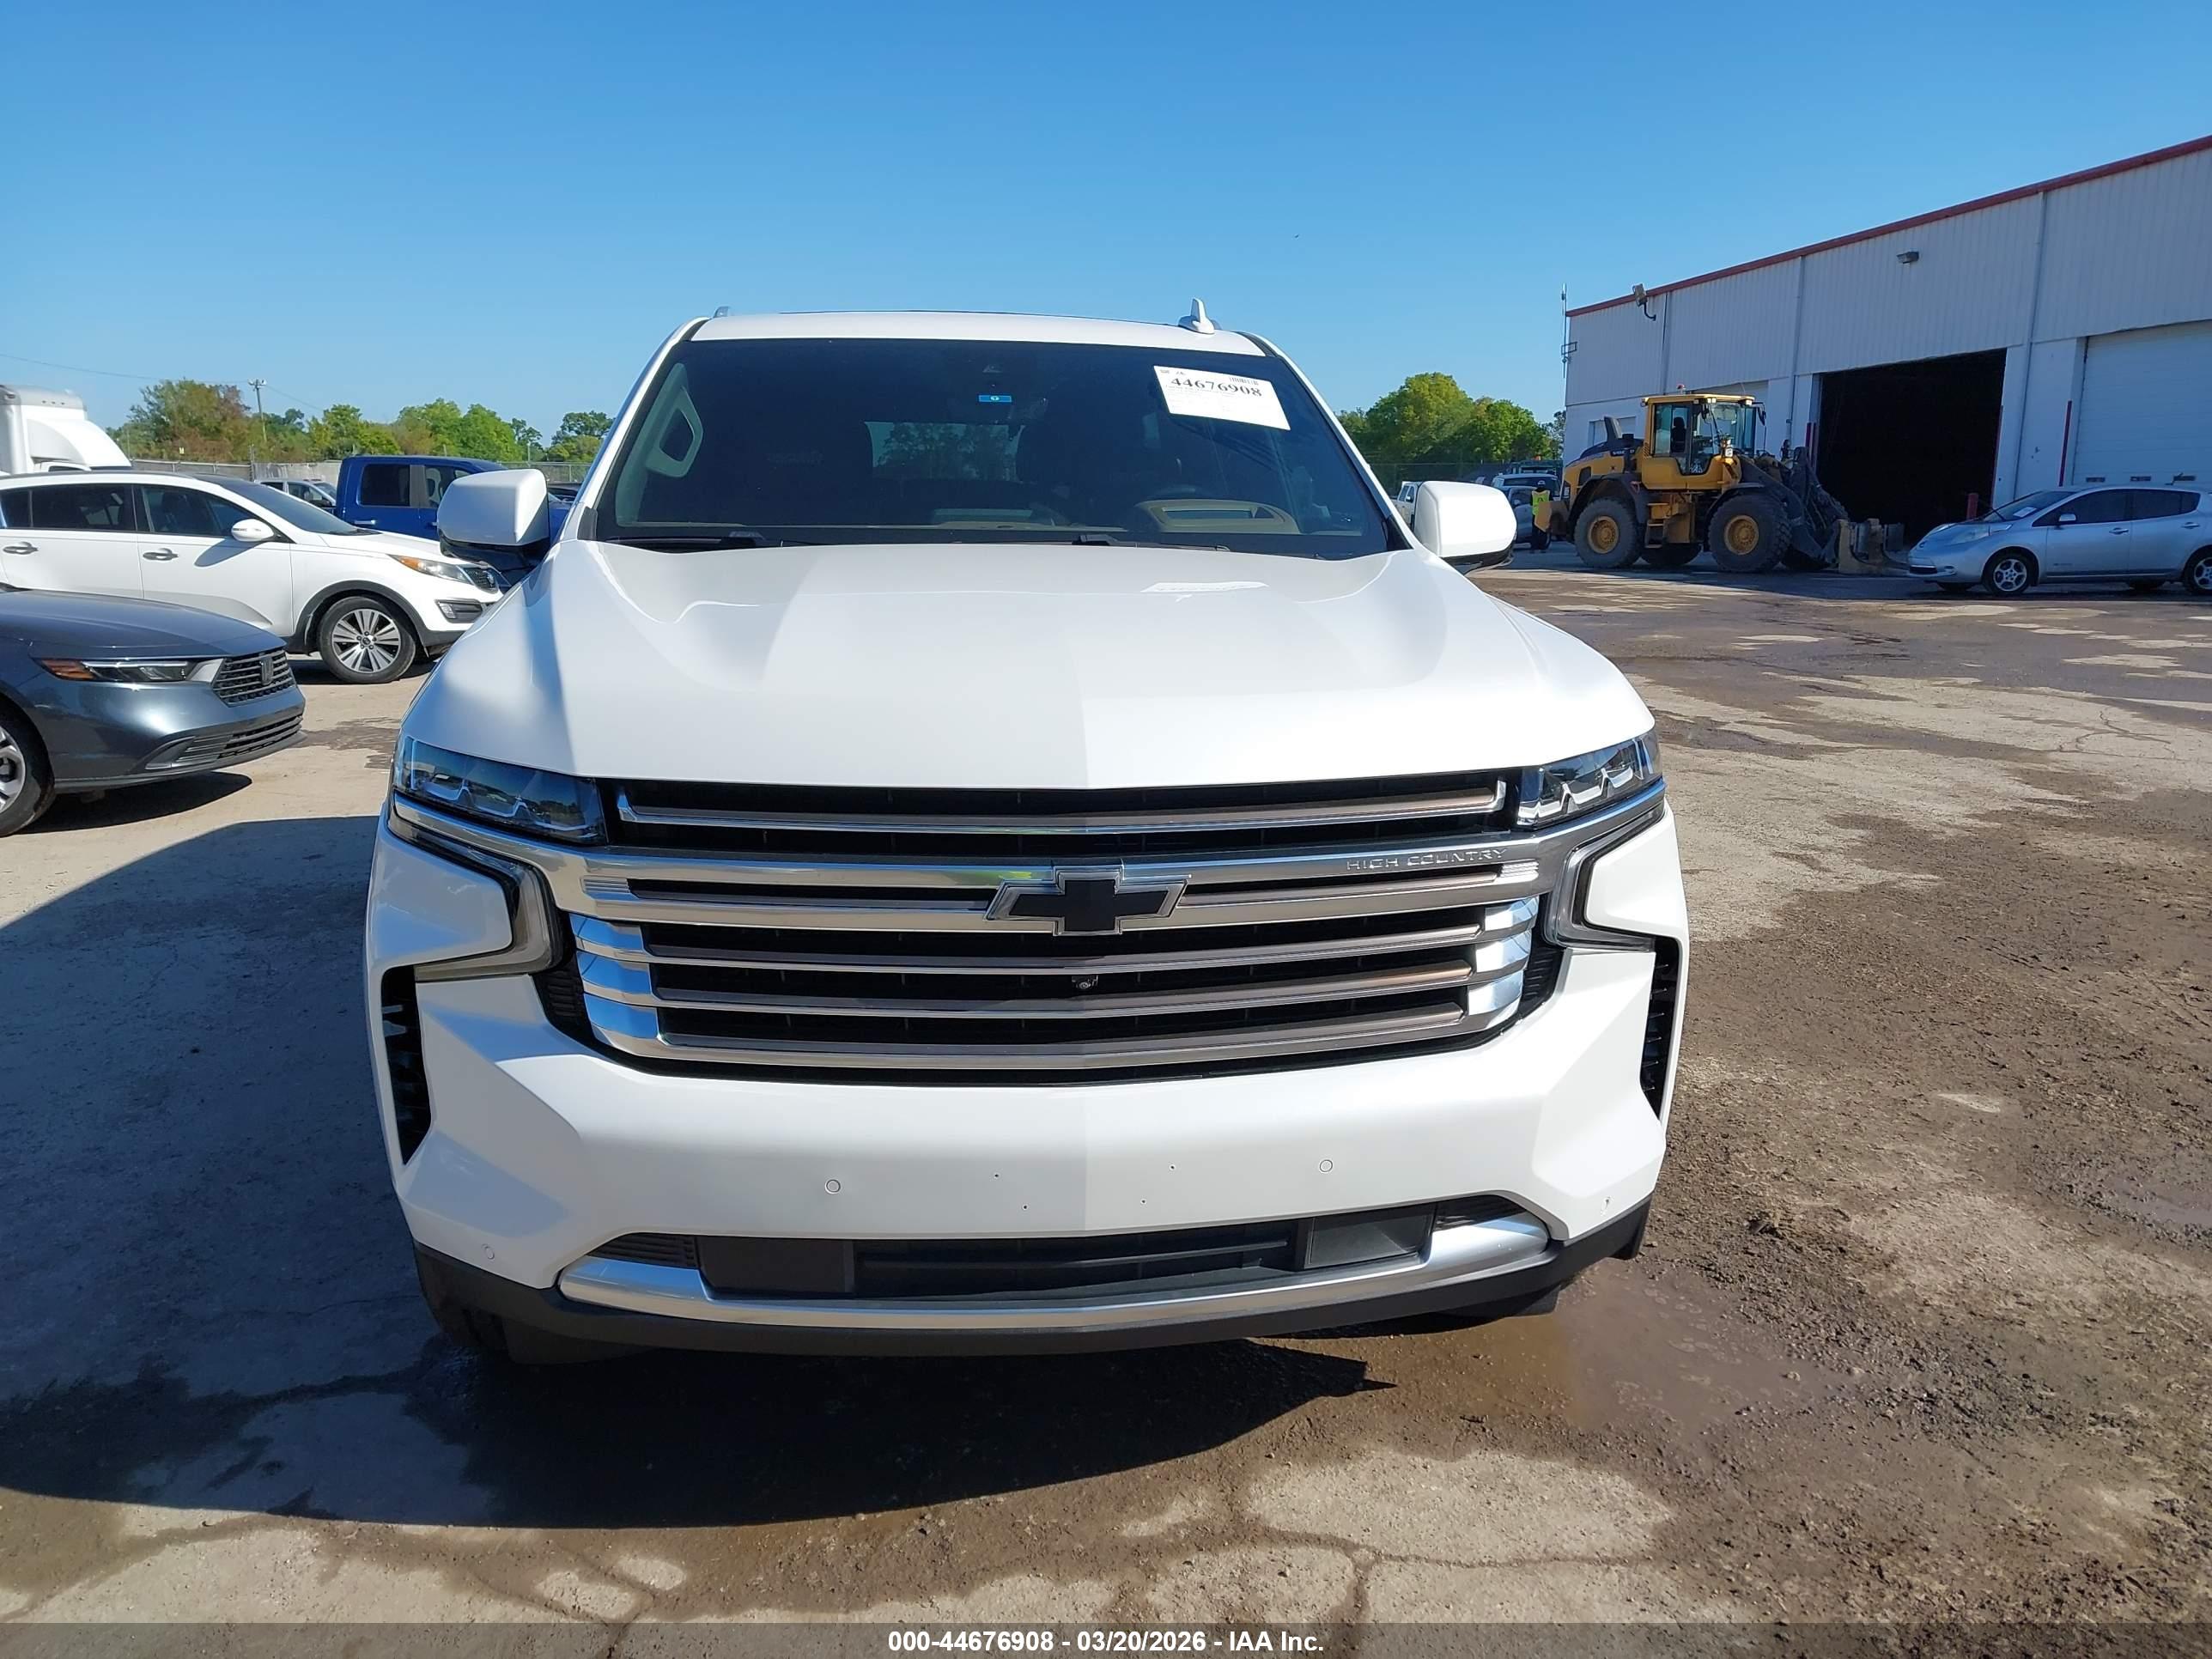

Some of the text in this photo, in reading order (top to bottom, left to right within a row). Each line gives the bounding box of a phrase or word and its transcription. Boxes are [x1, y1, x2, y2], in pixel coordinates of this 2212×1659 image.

[1170, 378, 1262, 397] 44676908
[1346, 848, 1508, 871] HIGH COUNTRY
